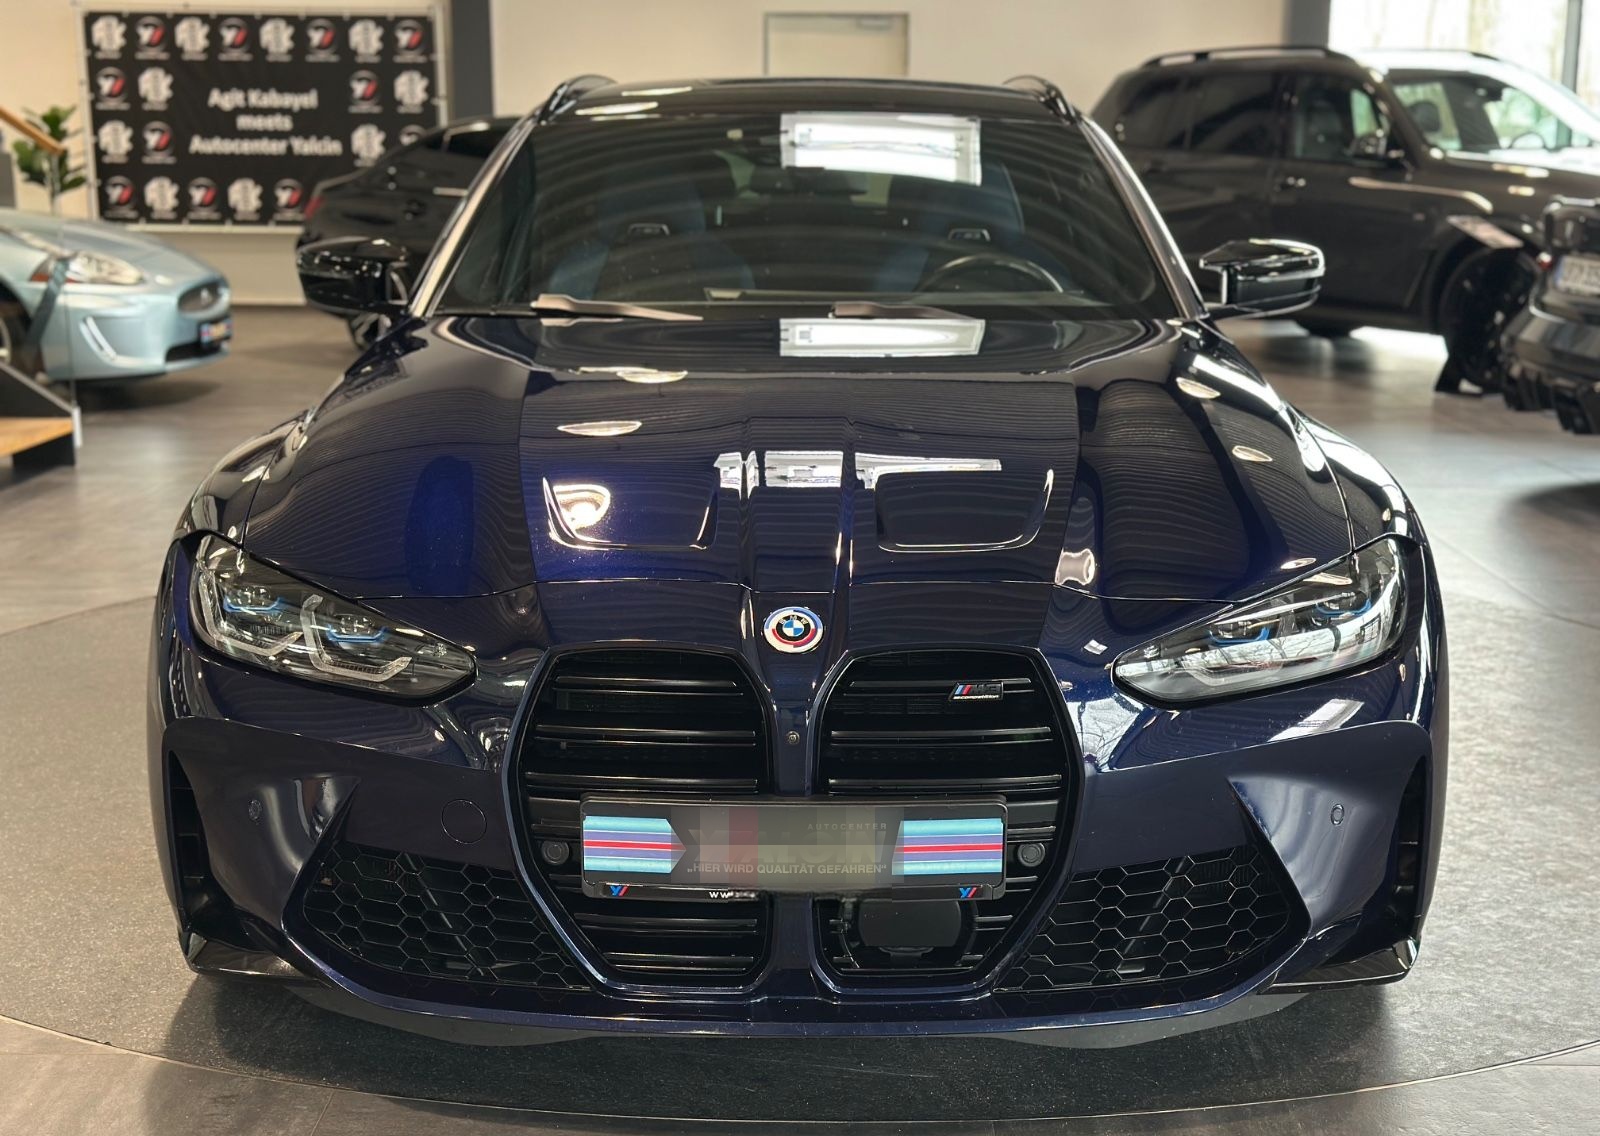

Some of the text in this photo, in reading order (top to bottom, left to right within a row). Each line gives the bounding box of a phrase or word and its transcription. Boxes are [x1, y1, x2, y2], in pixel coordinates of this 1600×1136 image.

[208, 88, 318, 112] Agit Kabayel
[236, 113, 293, 131] meets
[188, 135, 288, 155] Autocenter
[807, 822, 888, 831] AUTOCENTER
[723, 863, 754, 873] WIRD
[757, 863, 813, 874] QUALITÄT
